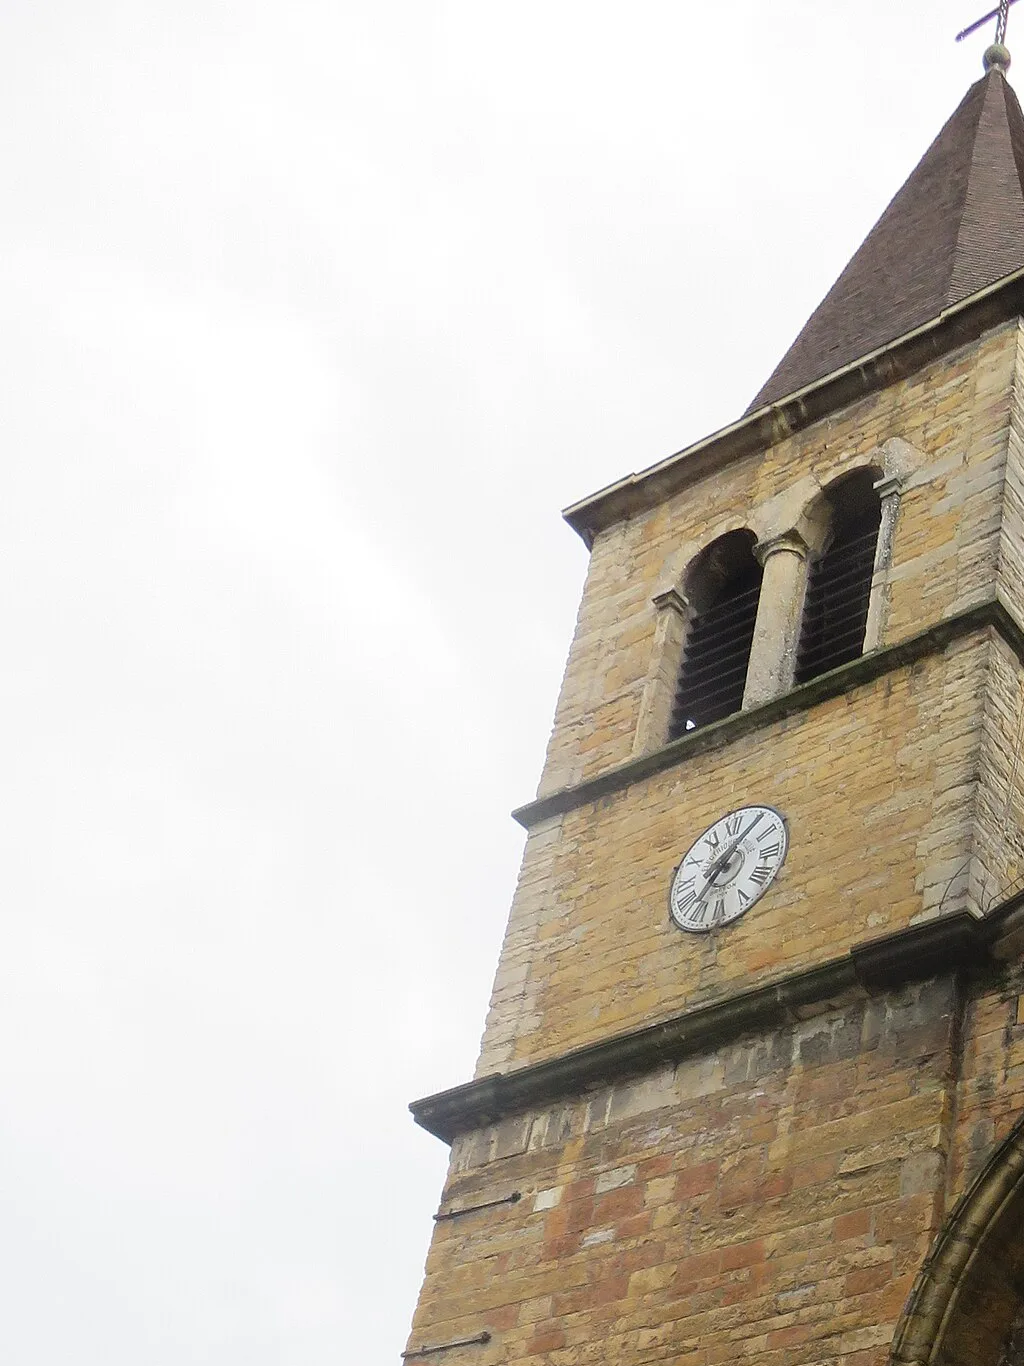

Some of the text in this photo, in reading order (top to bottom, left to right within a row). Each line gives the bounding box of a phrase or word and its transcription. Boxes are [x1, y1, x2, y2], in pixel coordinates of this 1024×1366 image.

[759, 841, 779, 859] III
[686, 856, 705, 867] X
[676, 874, 697, 894] IX
[737, 889, 750, 906] V
